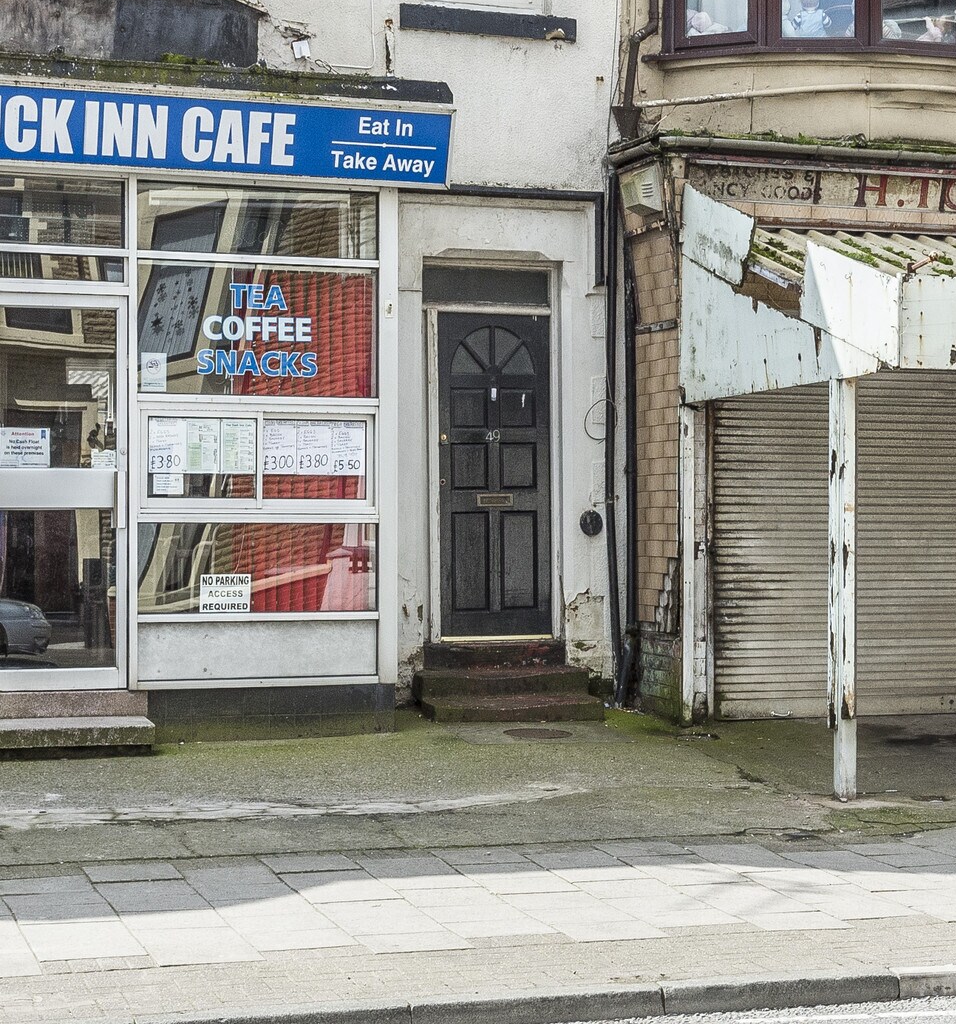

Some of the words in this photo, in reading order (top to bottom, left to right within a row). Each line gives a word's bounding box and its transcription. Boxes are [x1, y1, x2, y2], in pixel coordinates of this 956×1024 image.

[0, 94, 75, 155] CK
[83, 100, 169, 160] INN
[181, 106, 296, 167] CAFE
[358, 116, 390, 136] Eat
[395, 119, 413, 137] In
[331, 150, 378, 171] Take
[382, 154, 435, 178] Away
[229, 282, 288, 311] TEA
[202, 315, 312, 342] COFFEE
[196, 348, 319, 377] SNACKS
[485, 429, 500, 443] 49
[202, 576, 214, 586] NO
[215, 576, 249, 586] PARKING
[208, 590, 243, 598] ACCESS
[202, 602, 248, 611] REQUIRED
